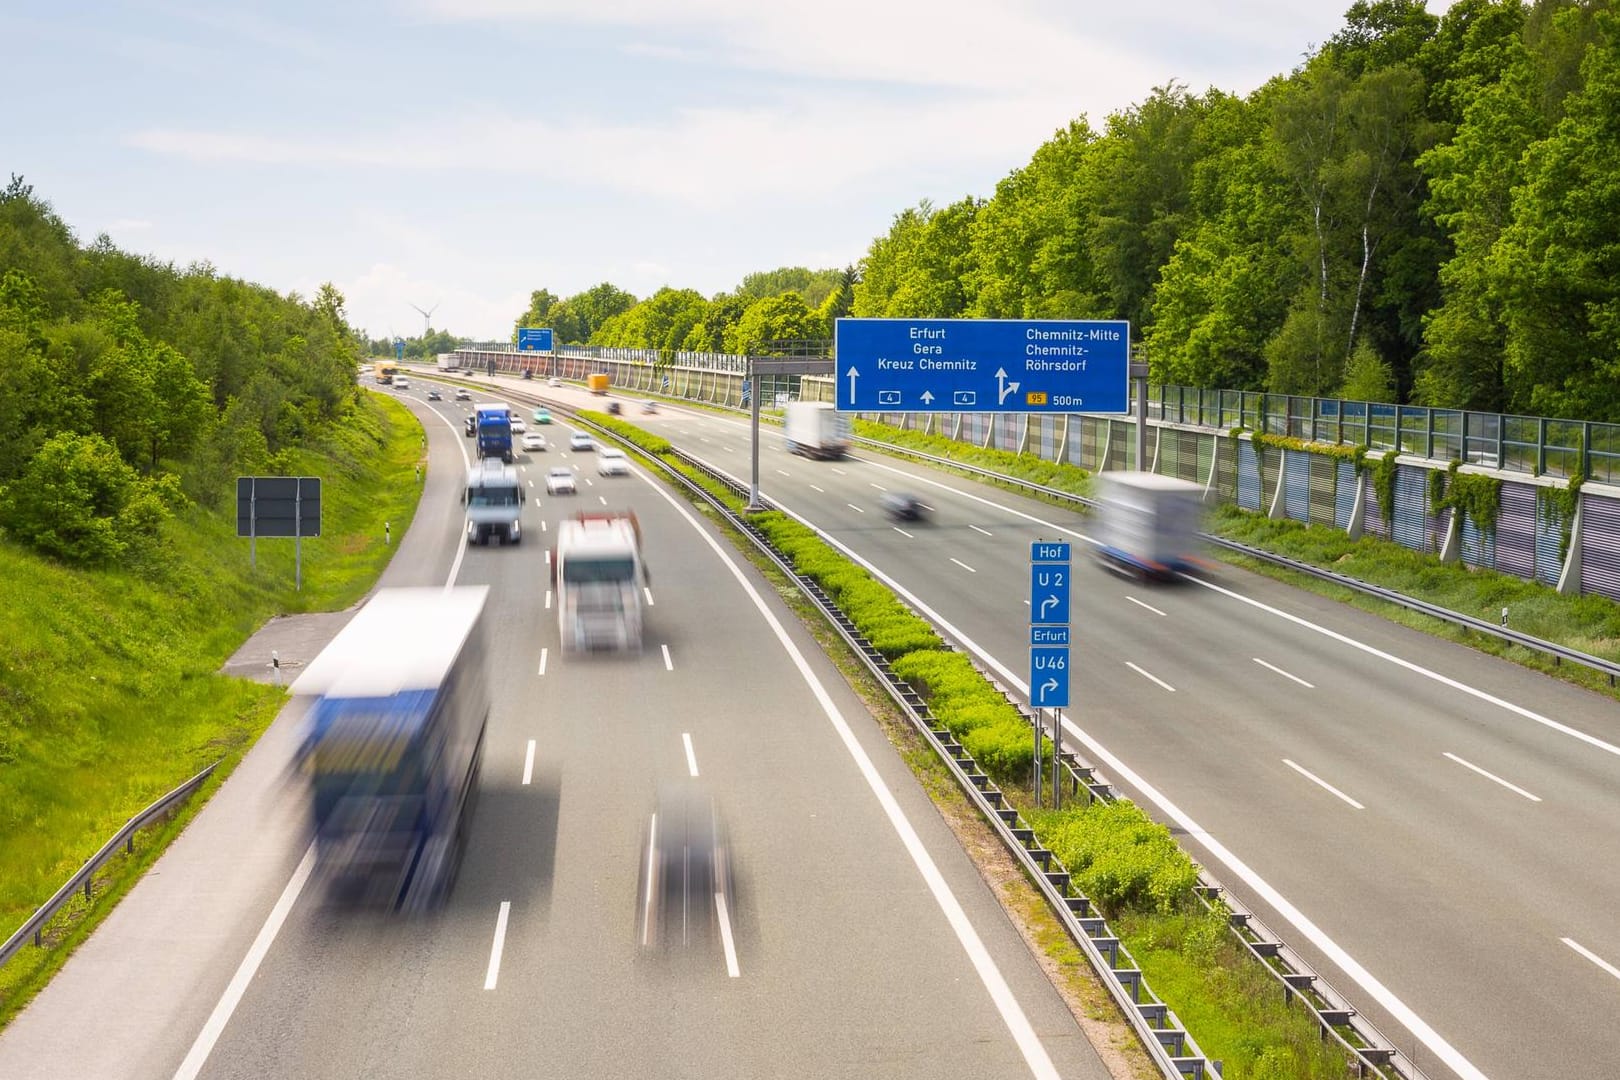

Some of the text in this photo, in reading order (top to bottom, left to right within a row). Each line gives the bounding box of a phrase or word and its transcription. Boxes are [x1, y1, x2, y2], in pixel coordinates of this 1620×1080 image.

[910, 327, 945, 339] Erfurt
[1026, 328, 1120, 341] Chemnitz-Mitte
[913, 343, 942, 355] Gera
[1026, 344, 1089, 356] Chemnitz-
[878, 358, 977, 370] Kreuz Chemnitz
[1026, 359, 1087, 371] Röhrsdorf
[1031, 394, 1042, 403] 95
[1040, 546, 1062, 558] Hof
[1034, 630, 1066, 641] Erfurt
